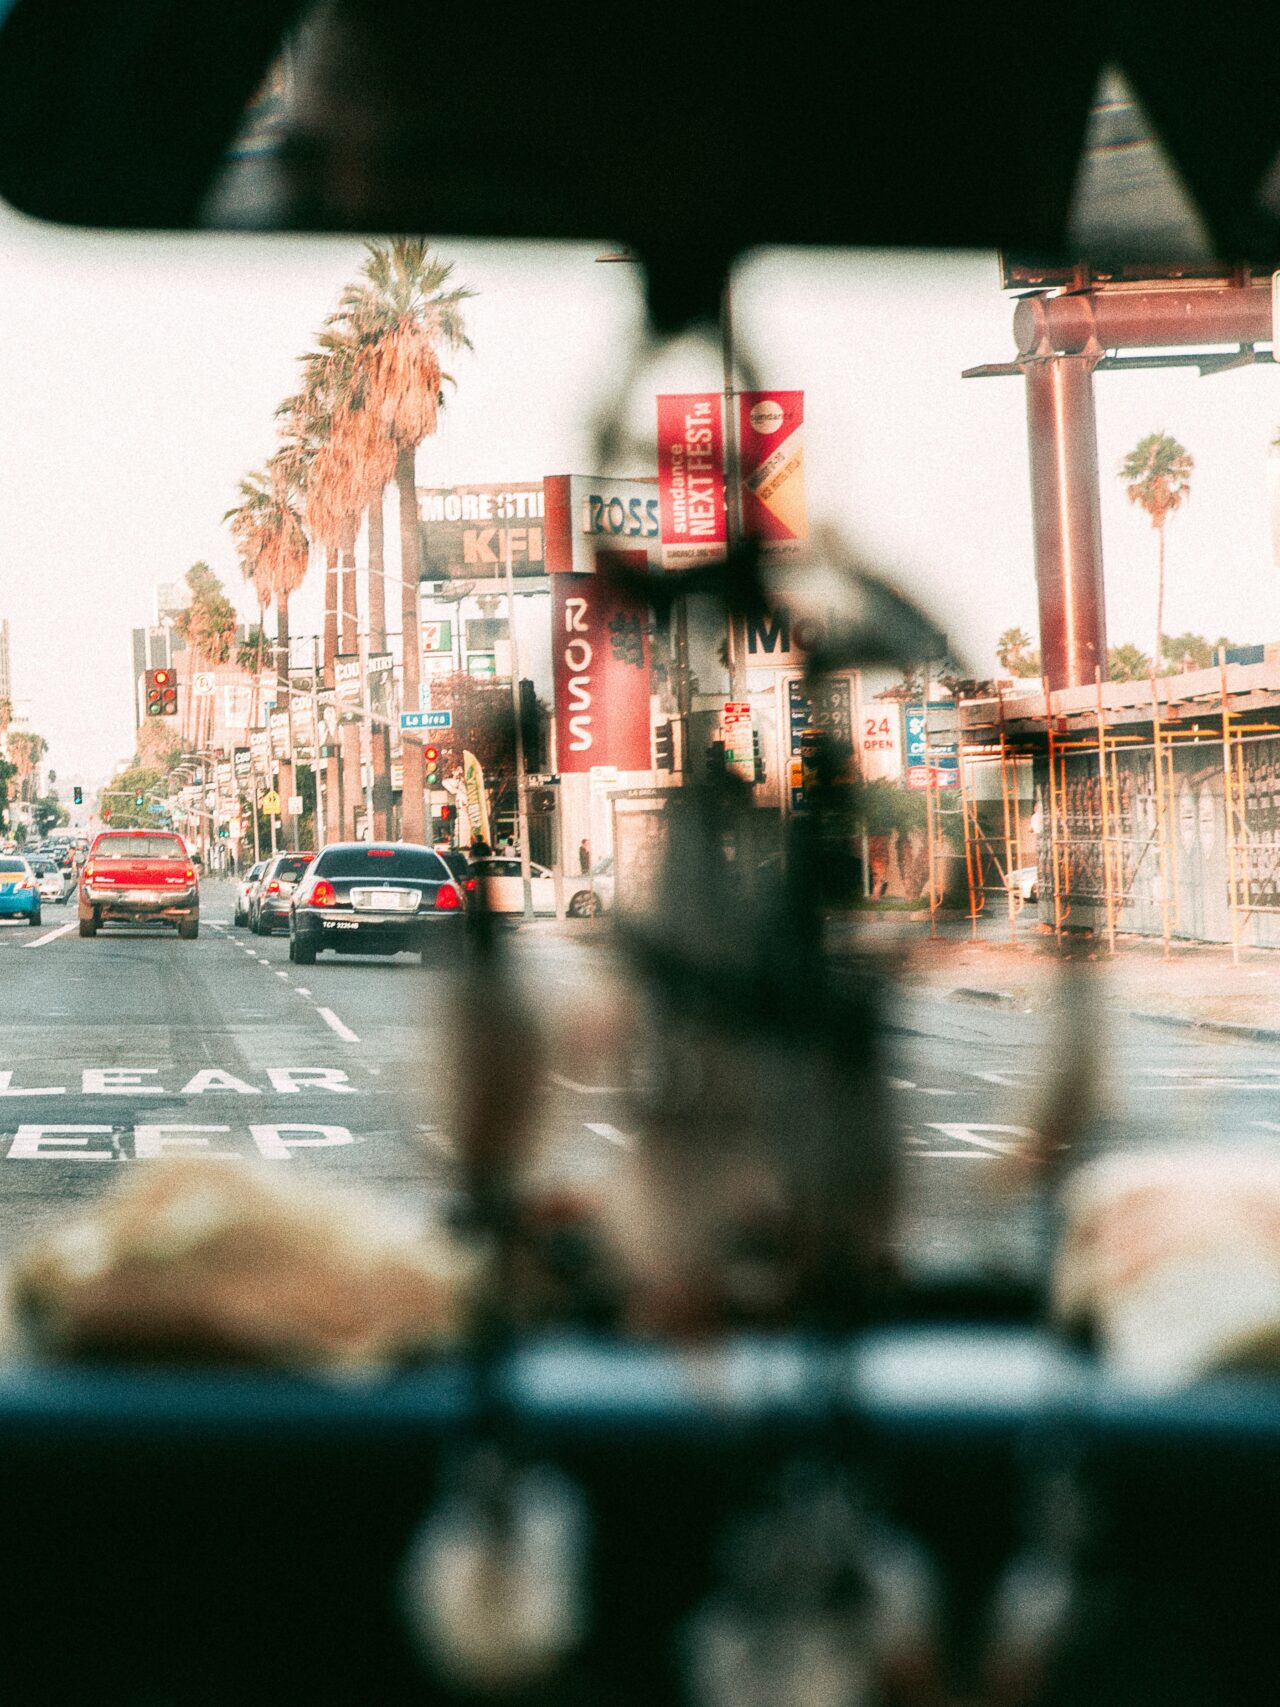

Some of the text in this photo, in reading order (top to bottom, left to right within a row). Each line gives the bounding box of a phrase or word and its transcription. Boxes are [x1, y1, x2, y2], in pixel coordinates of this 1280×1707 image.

[671, 443, 687, 534] sundance
[420, 491, 544, 521] MORE STI
[585, 494, 659, 537] ROSS
[463, 528, 542, 563] KFI
[565, 598, 593, 751] ROSS
[405, 714, 446, 726] La Brea
[865, 718, 890, 735] 24
[864, 740, 893, 750] OPEN
